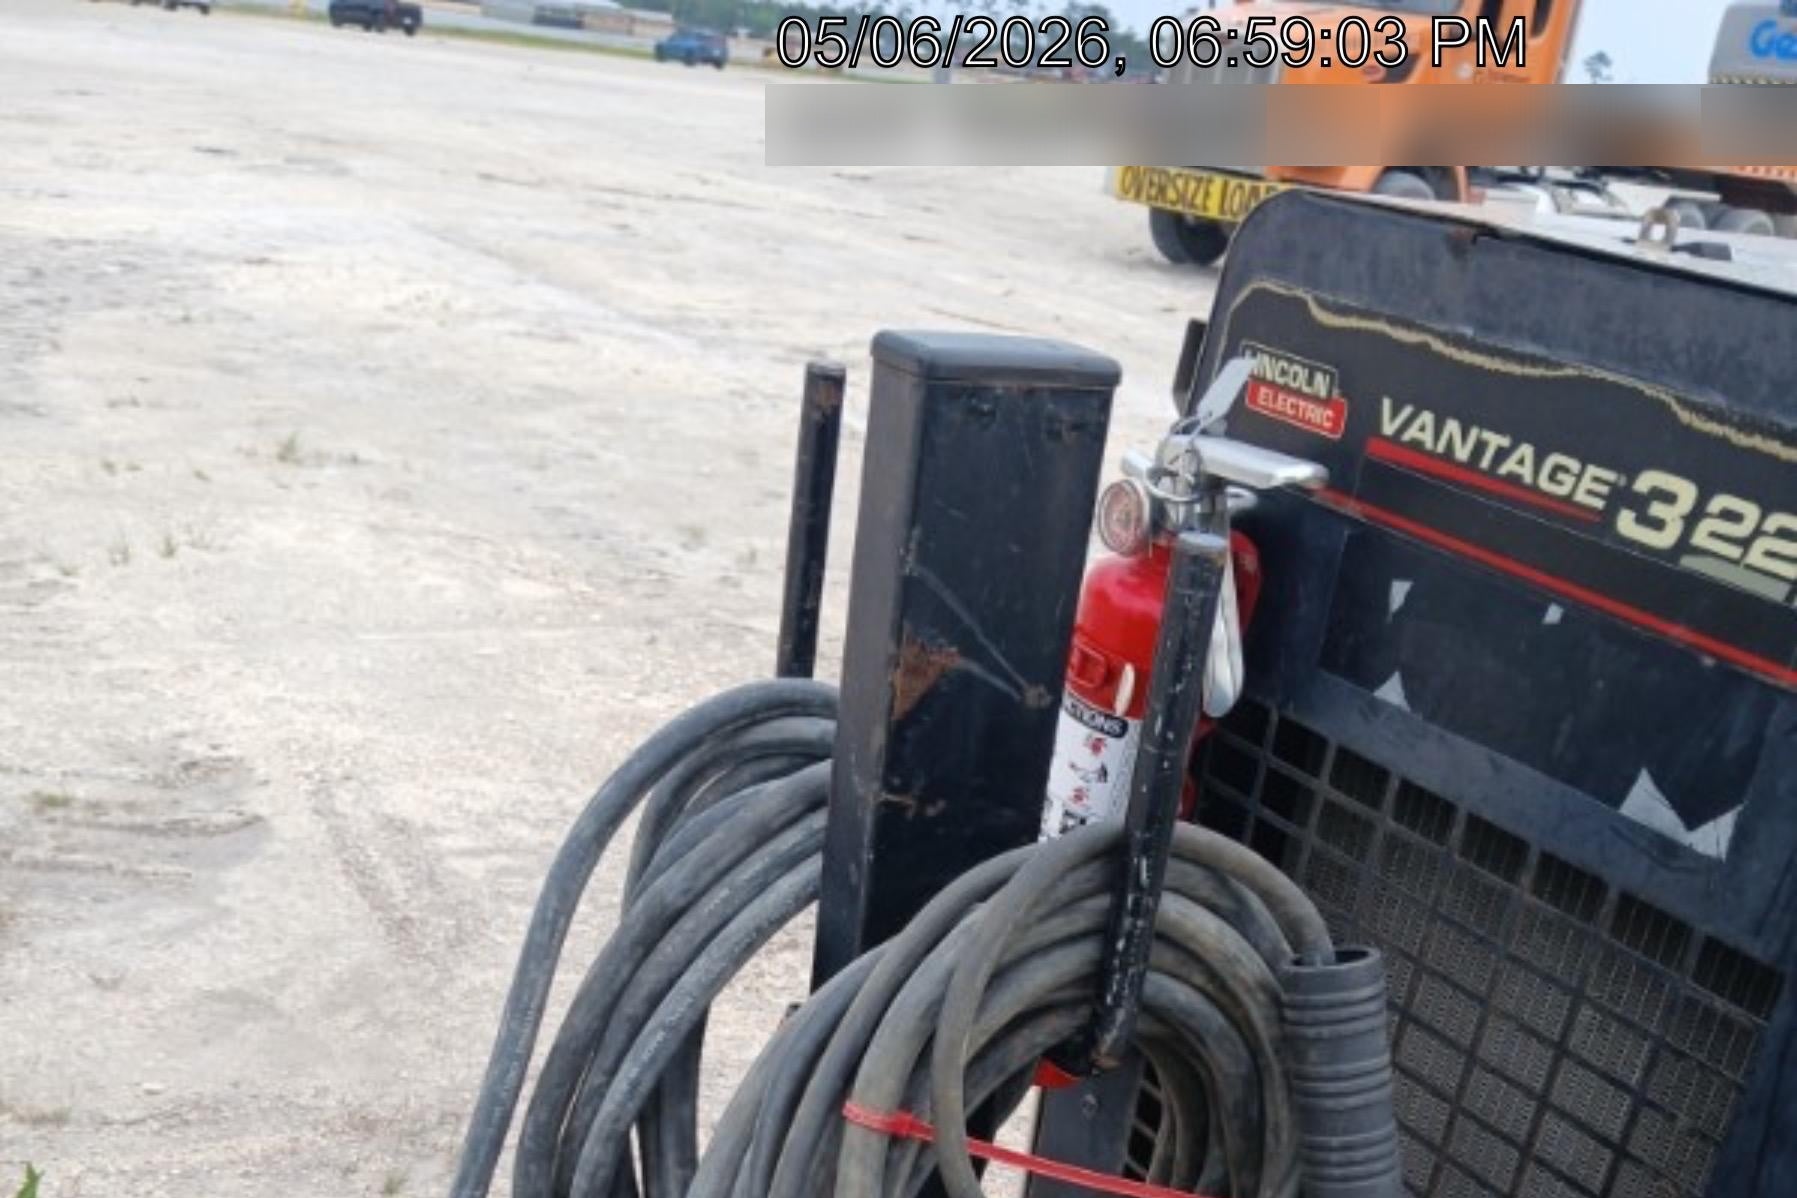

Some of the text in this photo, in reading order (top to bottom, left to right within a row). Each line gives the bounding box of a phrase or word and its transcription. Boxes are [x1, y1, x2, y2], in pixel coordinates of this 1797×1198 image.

[1119, 166, 1214, 213] OVERSIZE
[1258, 384, 1334, 429] ELECTRIC
[1381, 396, 1797, 579] VANTAGE 322
